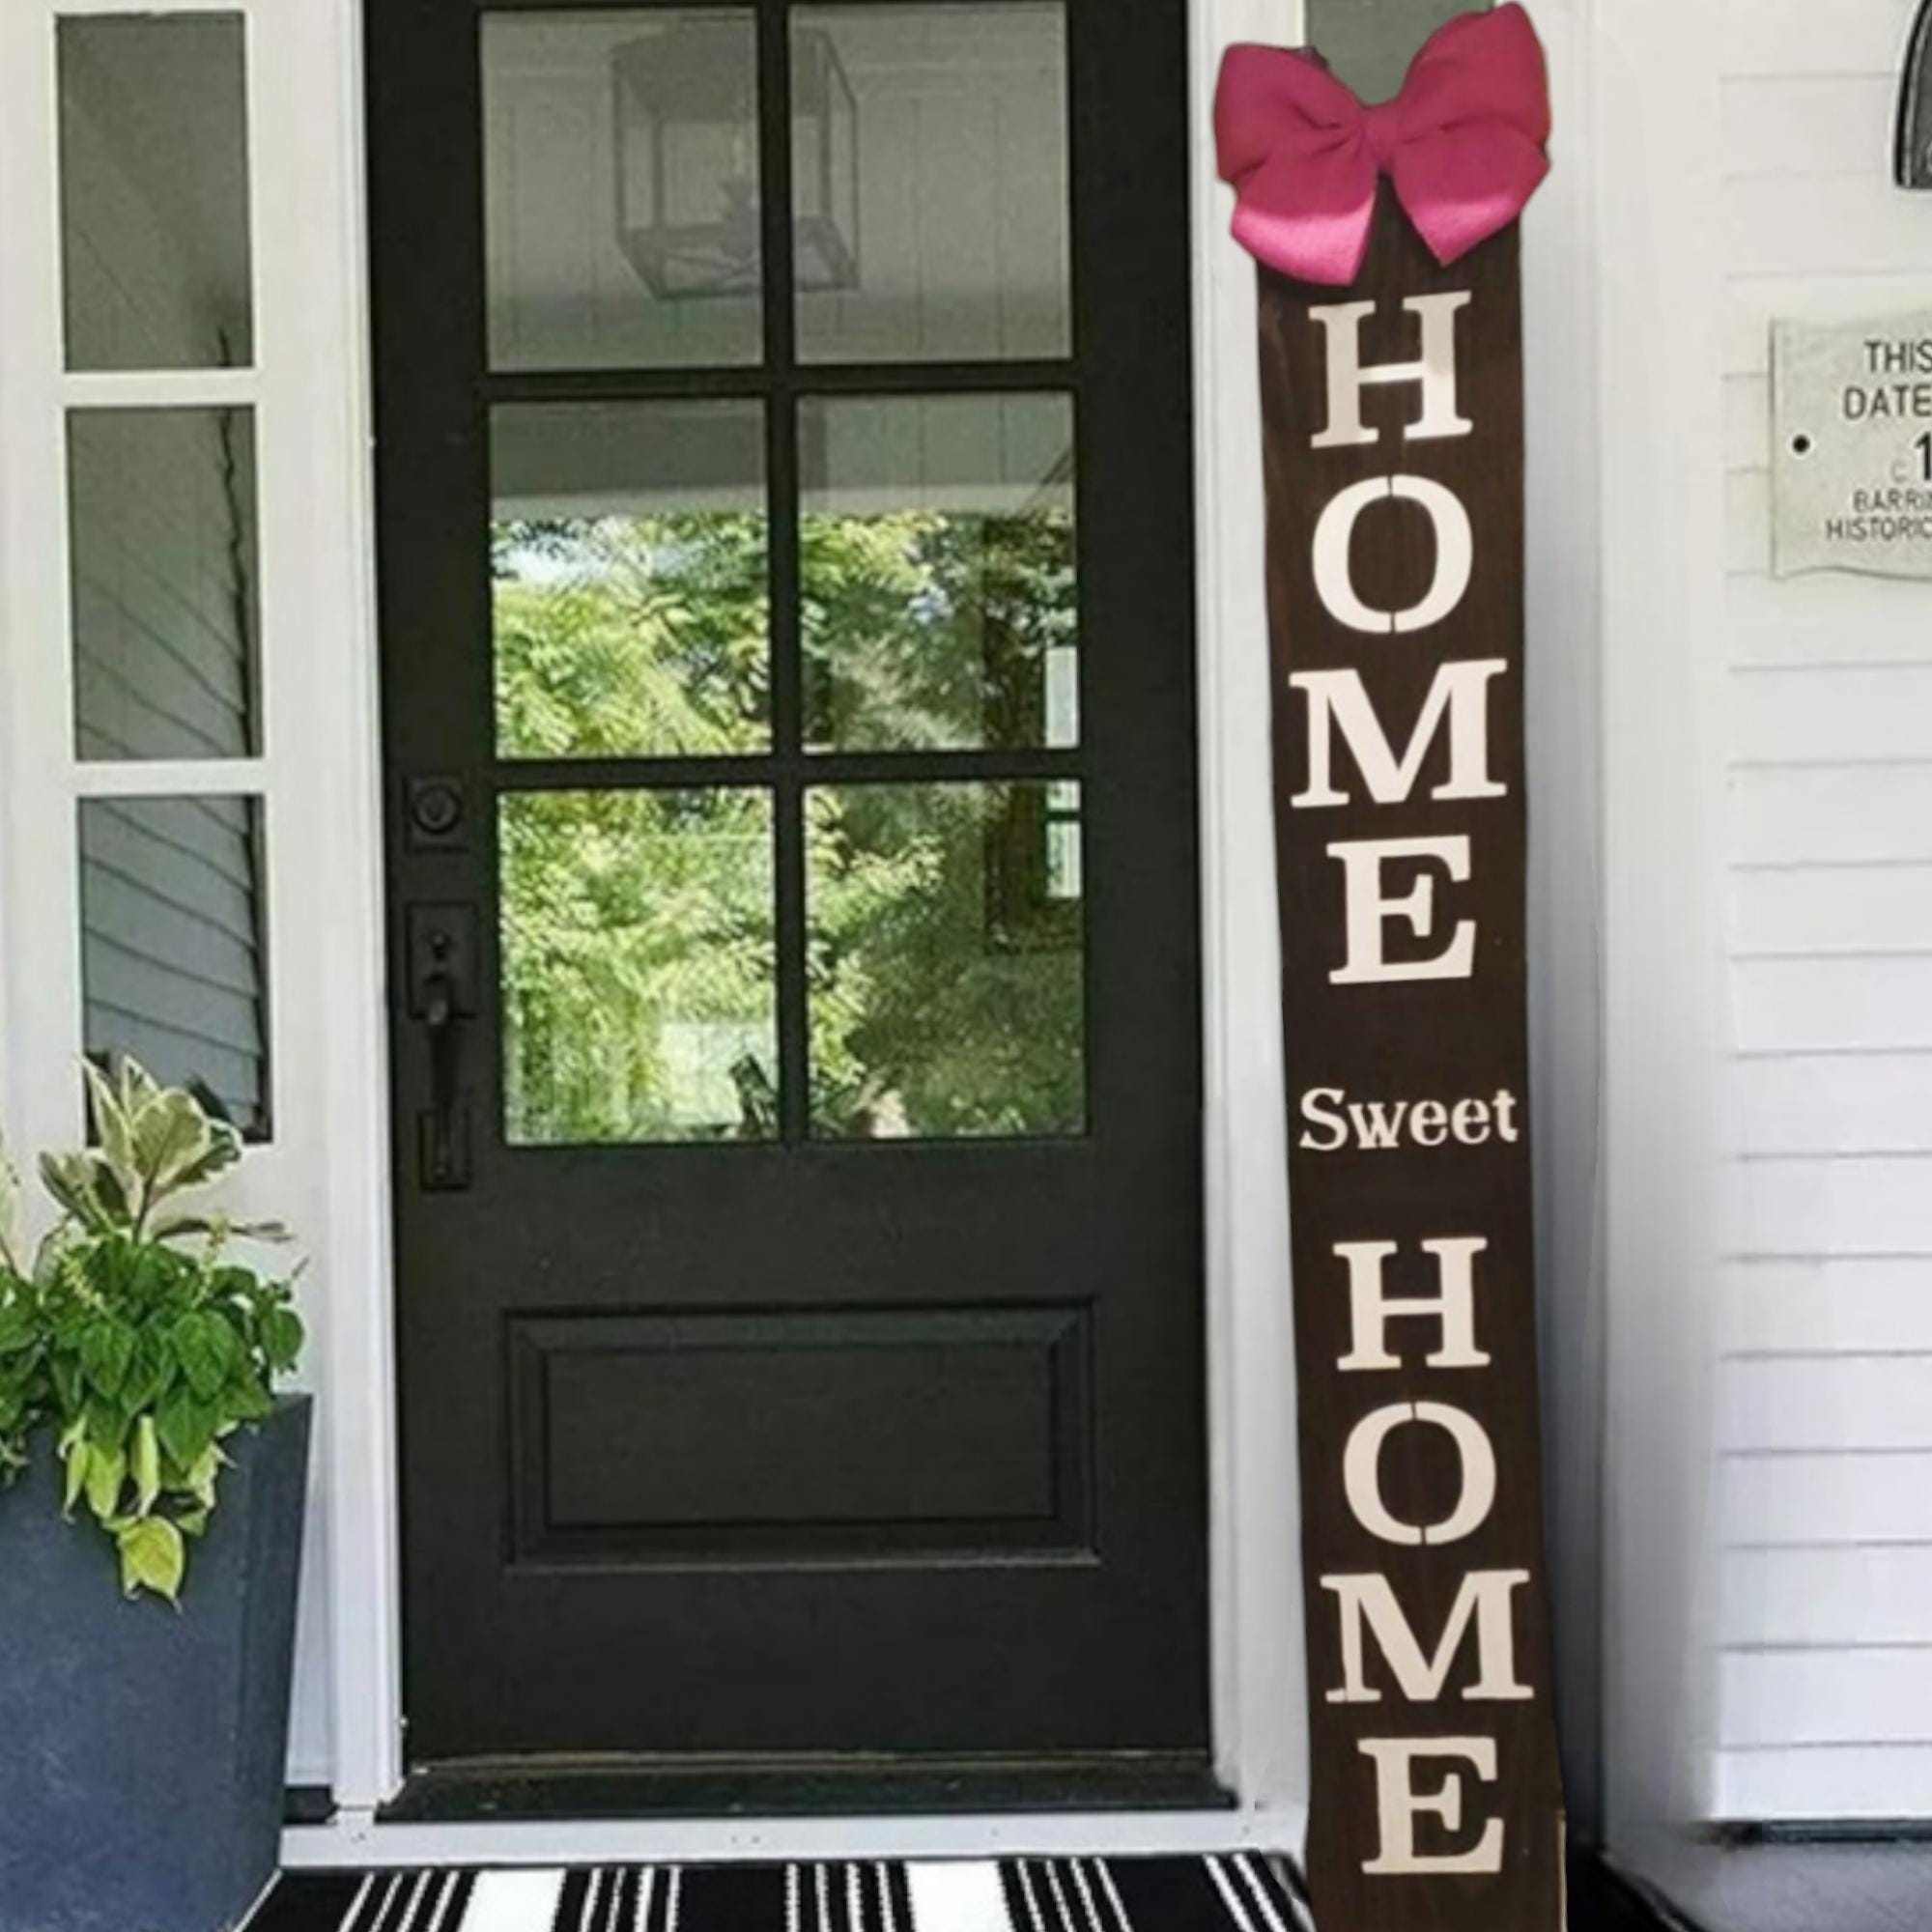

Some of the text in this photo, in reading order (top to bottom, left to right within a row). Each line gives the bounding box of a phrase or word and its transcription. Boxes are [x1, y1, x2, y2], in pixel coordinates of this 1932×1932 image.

[1864, 340, 1932, 373] THIS
[1843, 385, 1932, 419] DATE
[1290, 292, 1507, 983] HOME
[1299, 1088, 1519, 1151] Sweet
[1320, 1237, 1533, 1874] HOME
